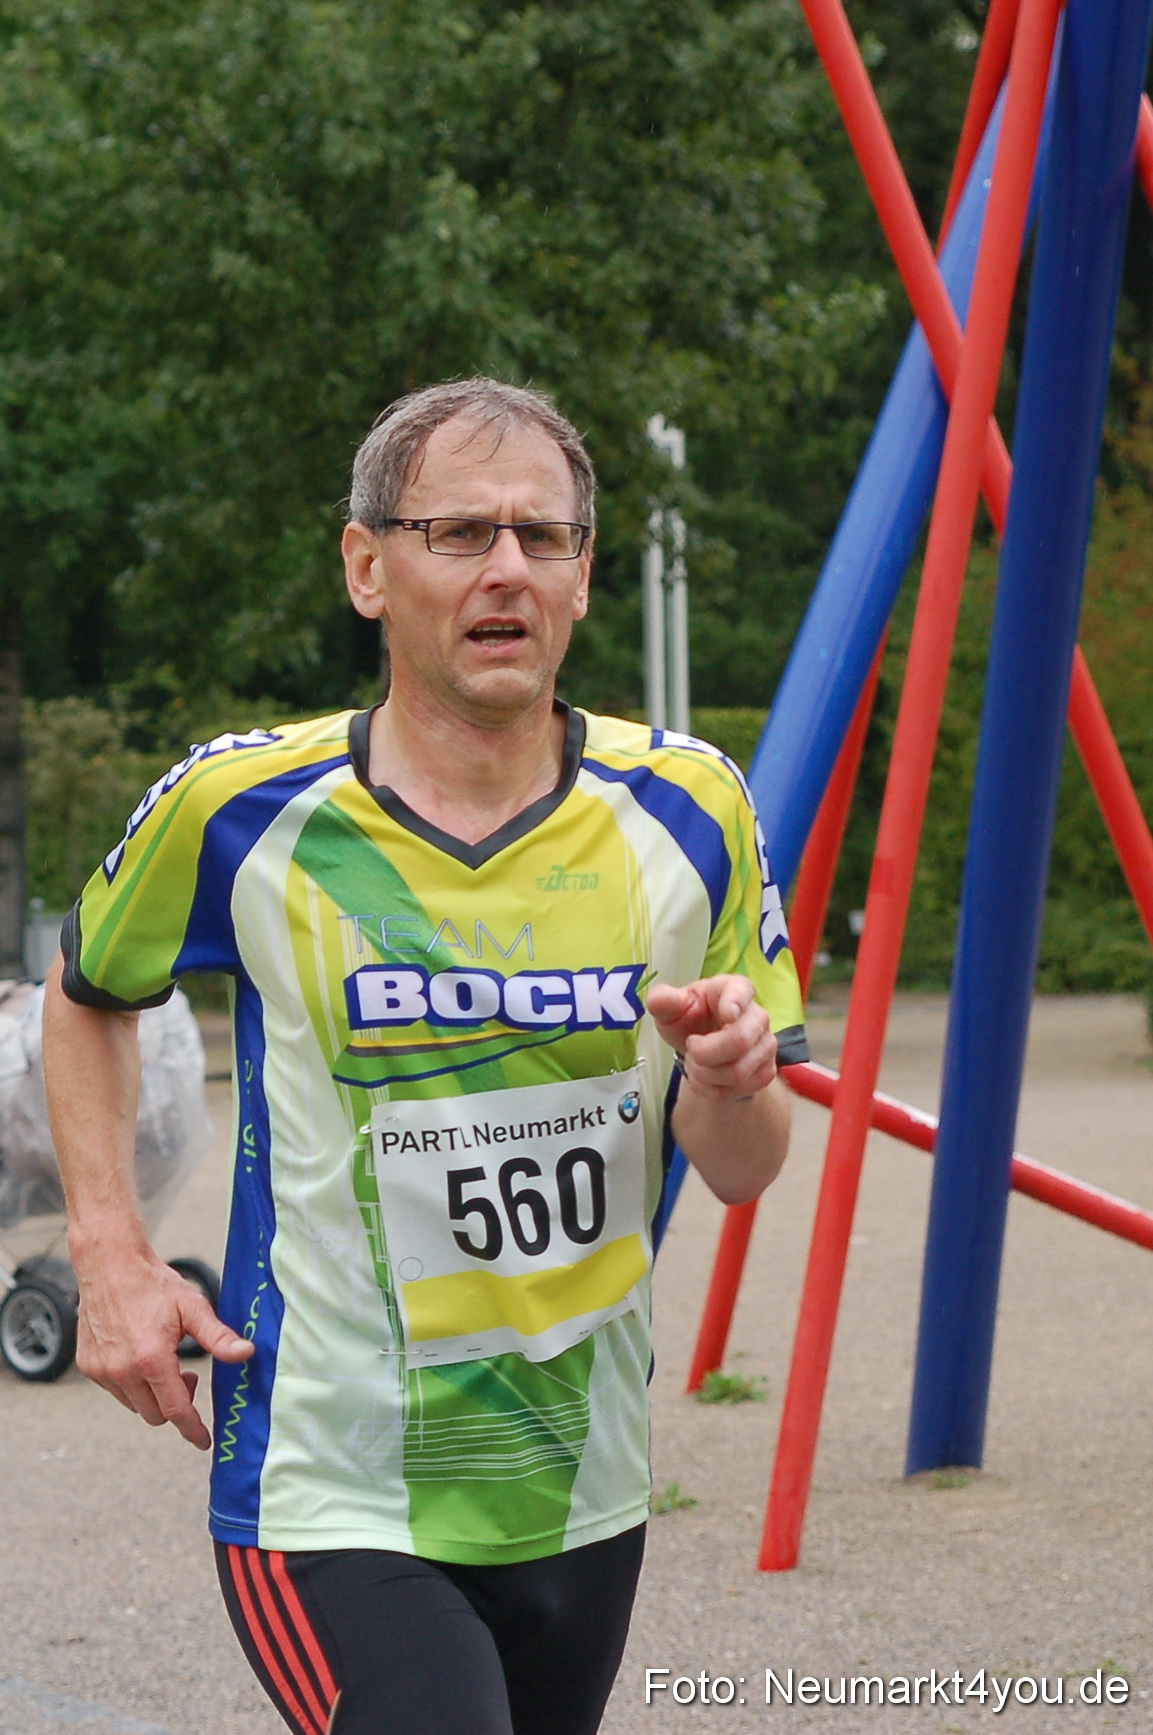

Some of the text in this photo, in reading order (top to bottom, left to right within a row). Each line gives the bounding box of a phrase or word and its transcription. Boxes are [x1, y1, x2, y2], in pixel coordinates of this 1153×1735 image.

[337, 914, 535, 961] TEAM
[345, 963, 646, 1030] BOCK
[473, 1105, 607, 1148] Neumarkt
[446, 1146, 606, 1262] 560
